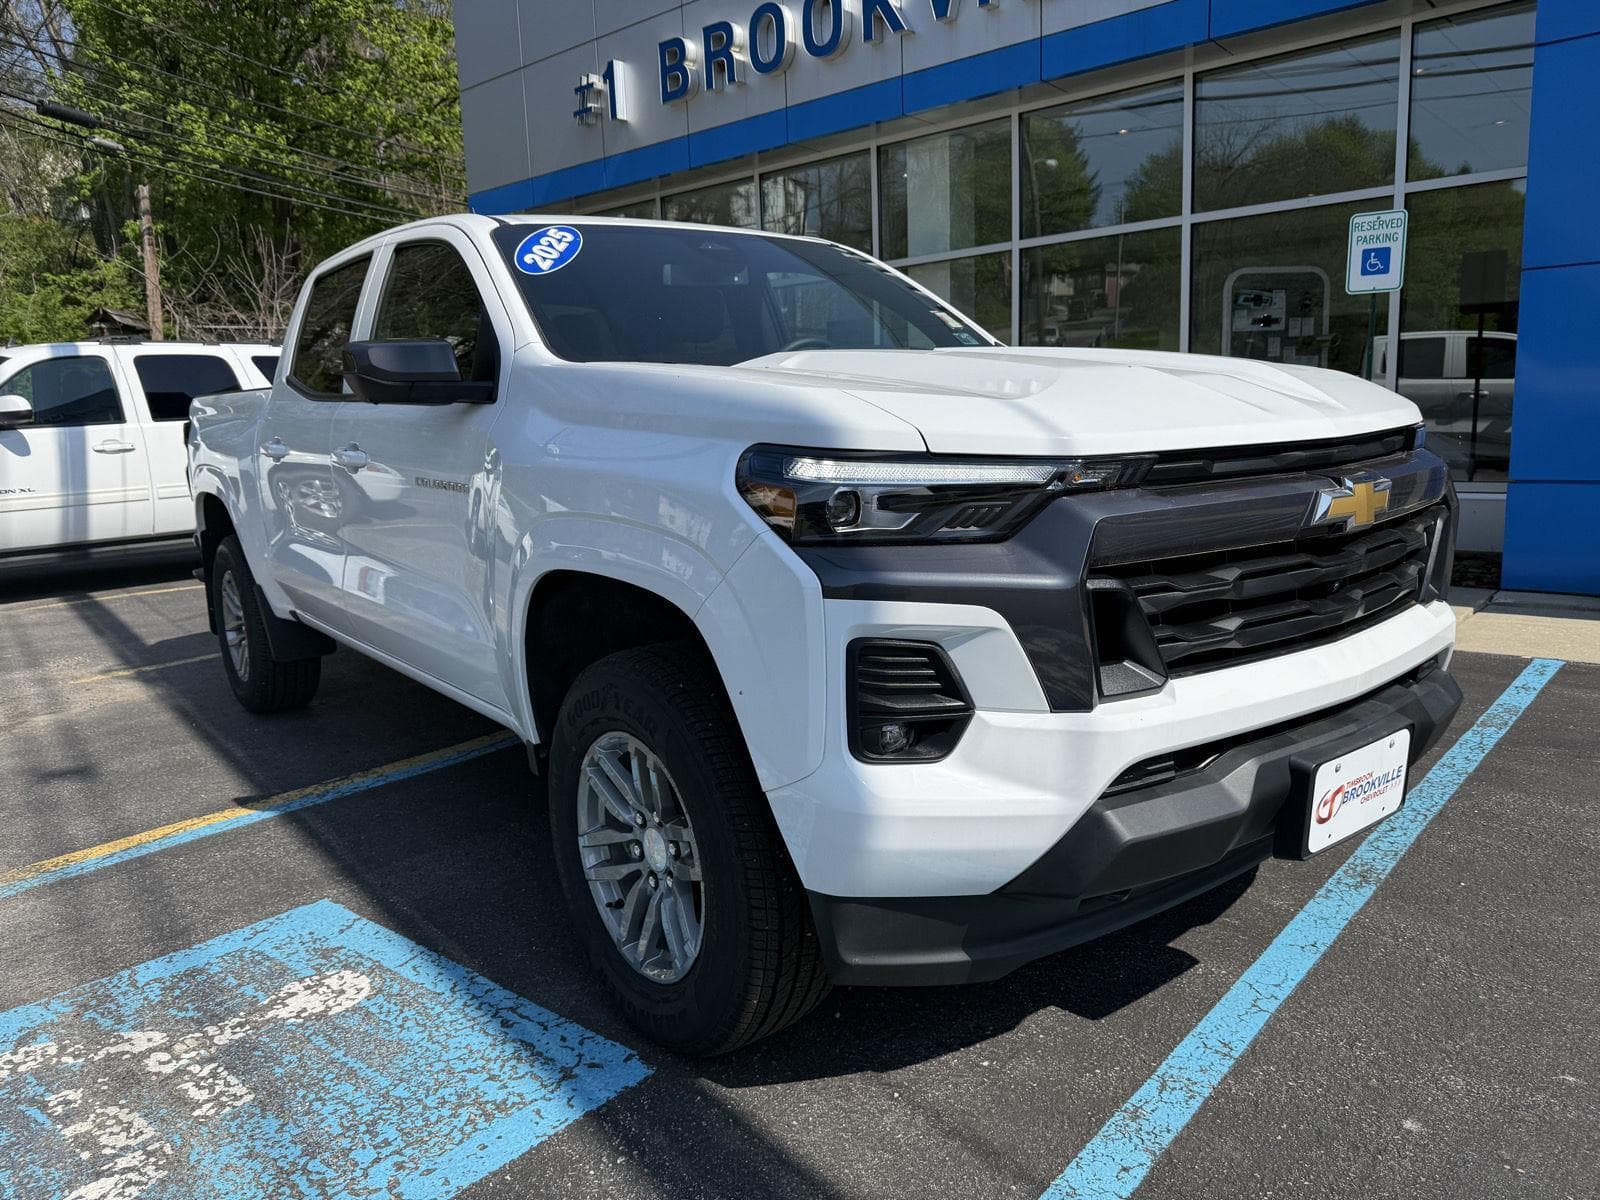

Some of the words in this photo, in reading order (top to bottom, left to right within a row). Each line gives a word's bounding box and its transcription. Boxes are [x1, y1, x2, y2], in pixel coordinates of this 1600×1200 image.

[1354, 217, 1403, 233] RESERVED
[1356, 232, 1399, 246] PARKING
[523, 228, 575, 271] 2025
[1342, 765, 1403, 804] BROOKVILLE
[1345, 770, 1375, 789] TIMBROOK
[1360, 784, 1389, 805] CHEVROLET
